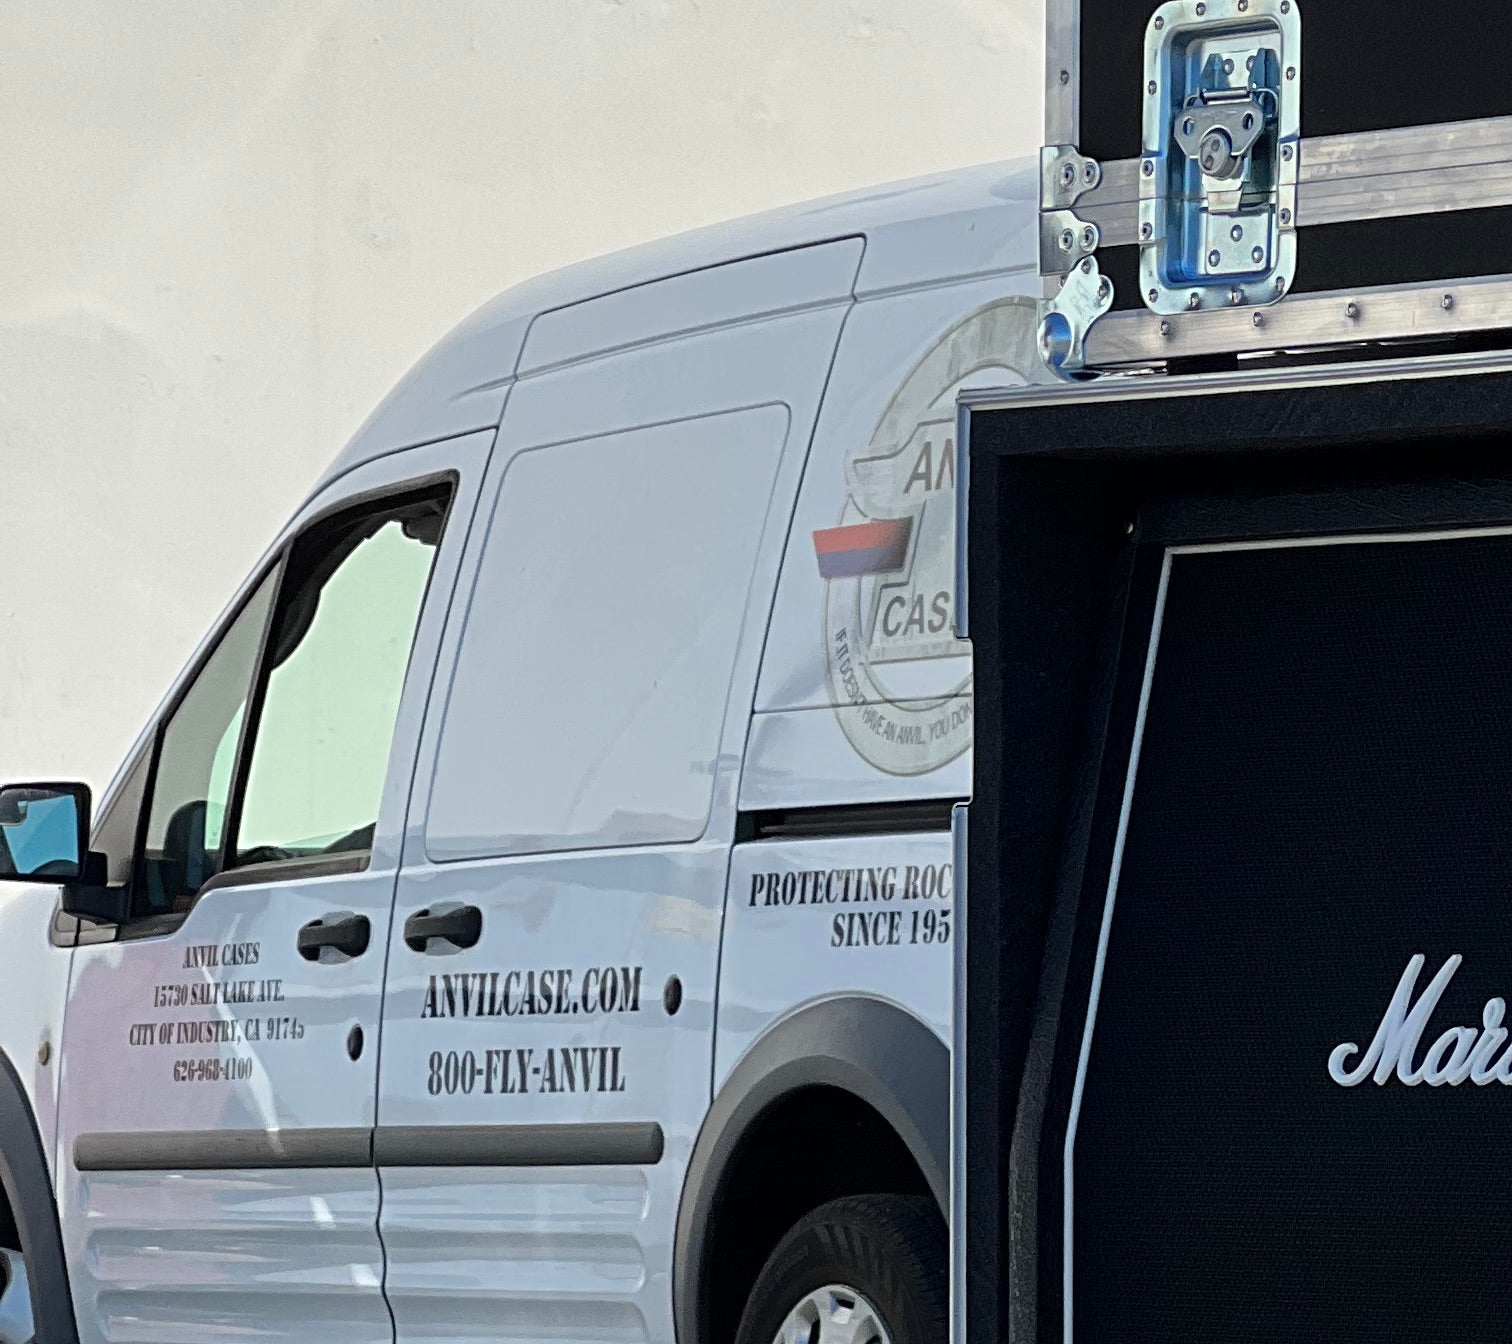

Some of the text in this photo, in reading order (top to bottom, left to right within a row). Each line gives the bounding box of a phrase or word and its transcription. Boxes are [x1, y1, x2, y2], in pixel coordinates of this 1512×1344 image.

[903, 438, 955, 495] AN
[882, 590, 954, 637] CAS
[928, 715, 950, 743] YOU
[952, 701, 973, 730] DON
[748, 862, 953, 907] PROTECTING ROC
[831, 908, 952, 948] SINCE 195
[182, 941, 261, 969] ANVIL CASES
[153, 978, 285, 1008] 15730 SALT LAKE AVE.
[420, 965, 642, 1019] ANVILCASE.COM
[129, 1015, 305, 1046] CITY OF INDUSTRY, CA 91745
[173, 1057, 253, 1082] 626-968-4100
[427, 1045, 626, 1097] 800-FLY-ANVIL
